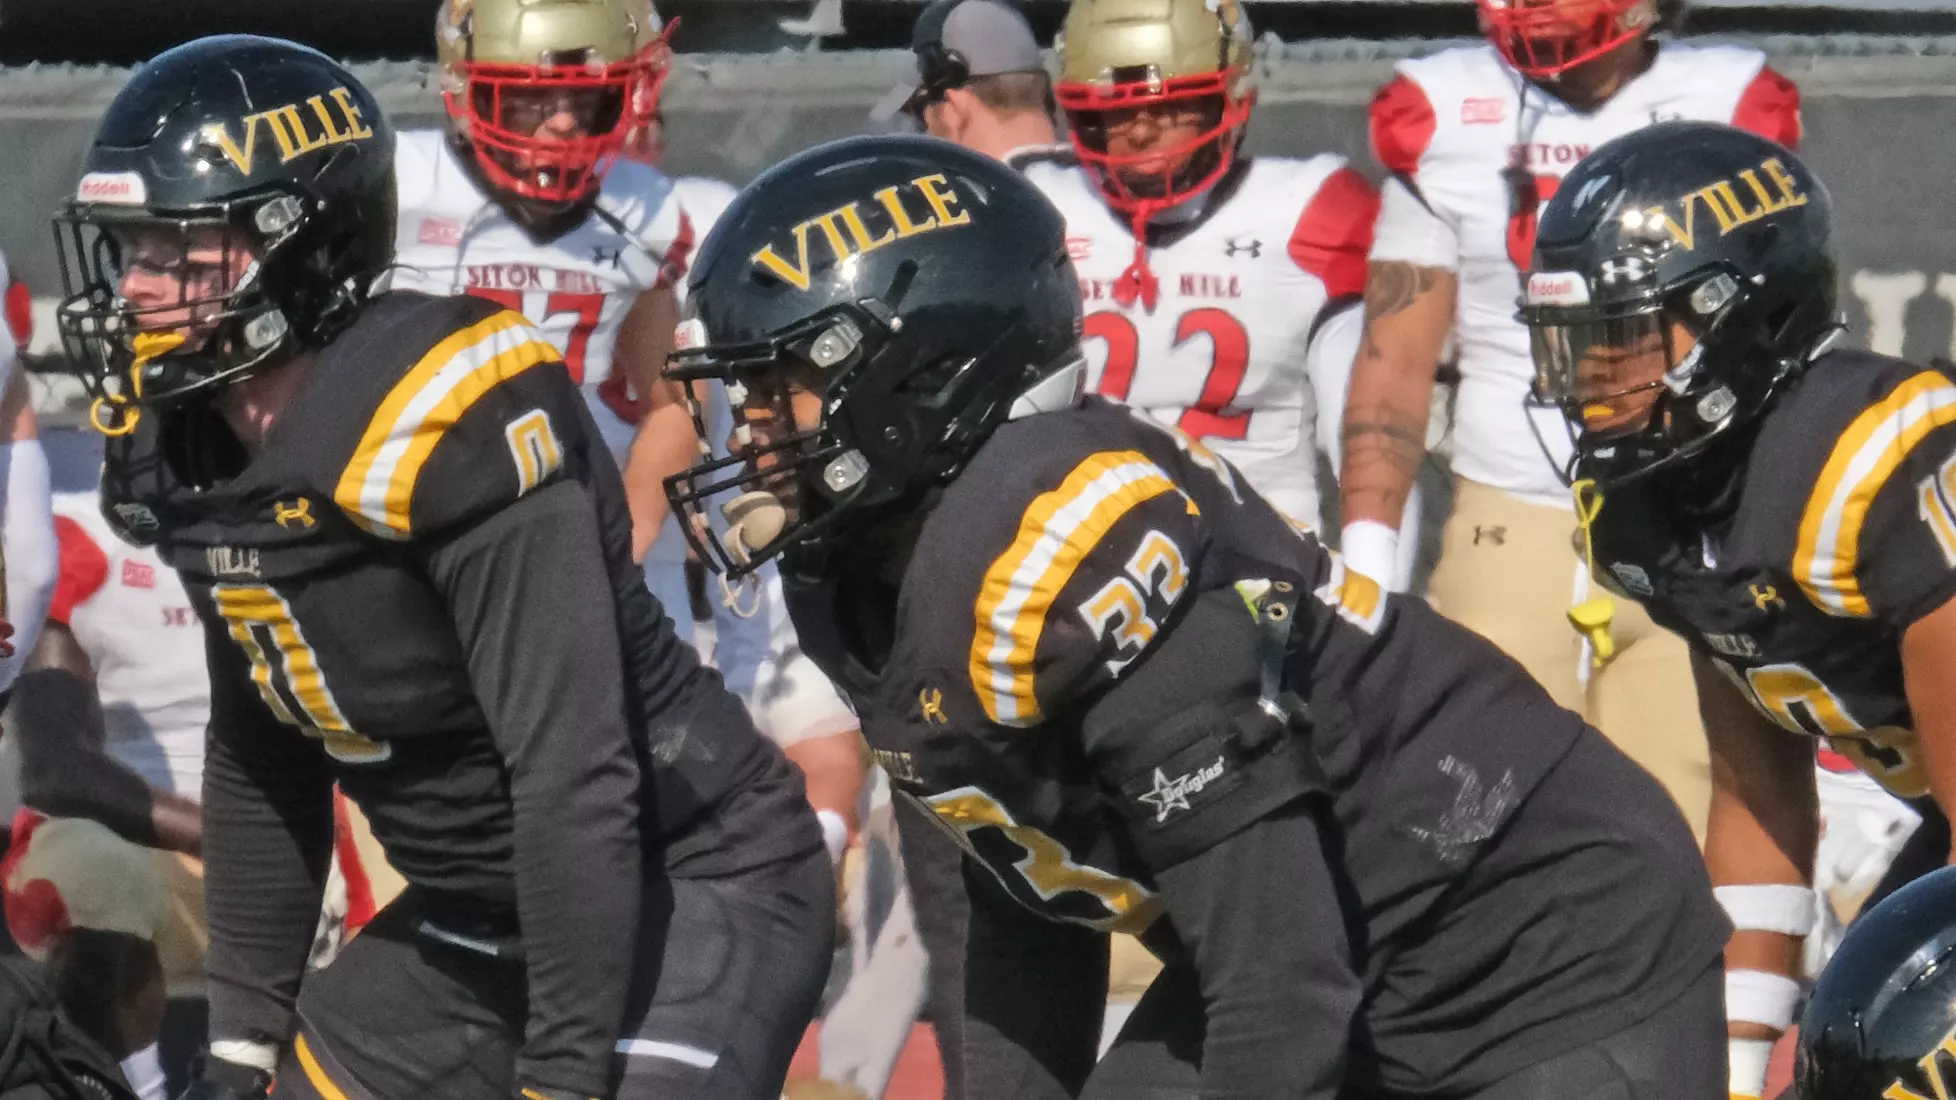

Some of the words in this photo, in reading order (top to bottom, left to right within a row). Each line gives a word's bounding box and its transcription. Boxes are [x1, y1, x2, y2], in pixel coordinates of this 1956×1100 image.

[203, 86, 373, 176] VILLE
[751, 173, 971, 291] VILLE
[1645, 158, 1808, 251] VILLE
